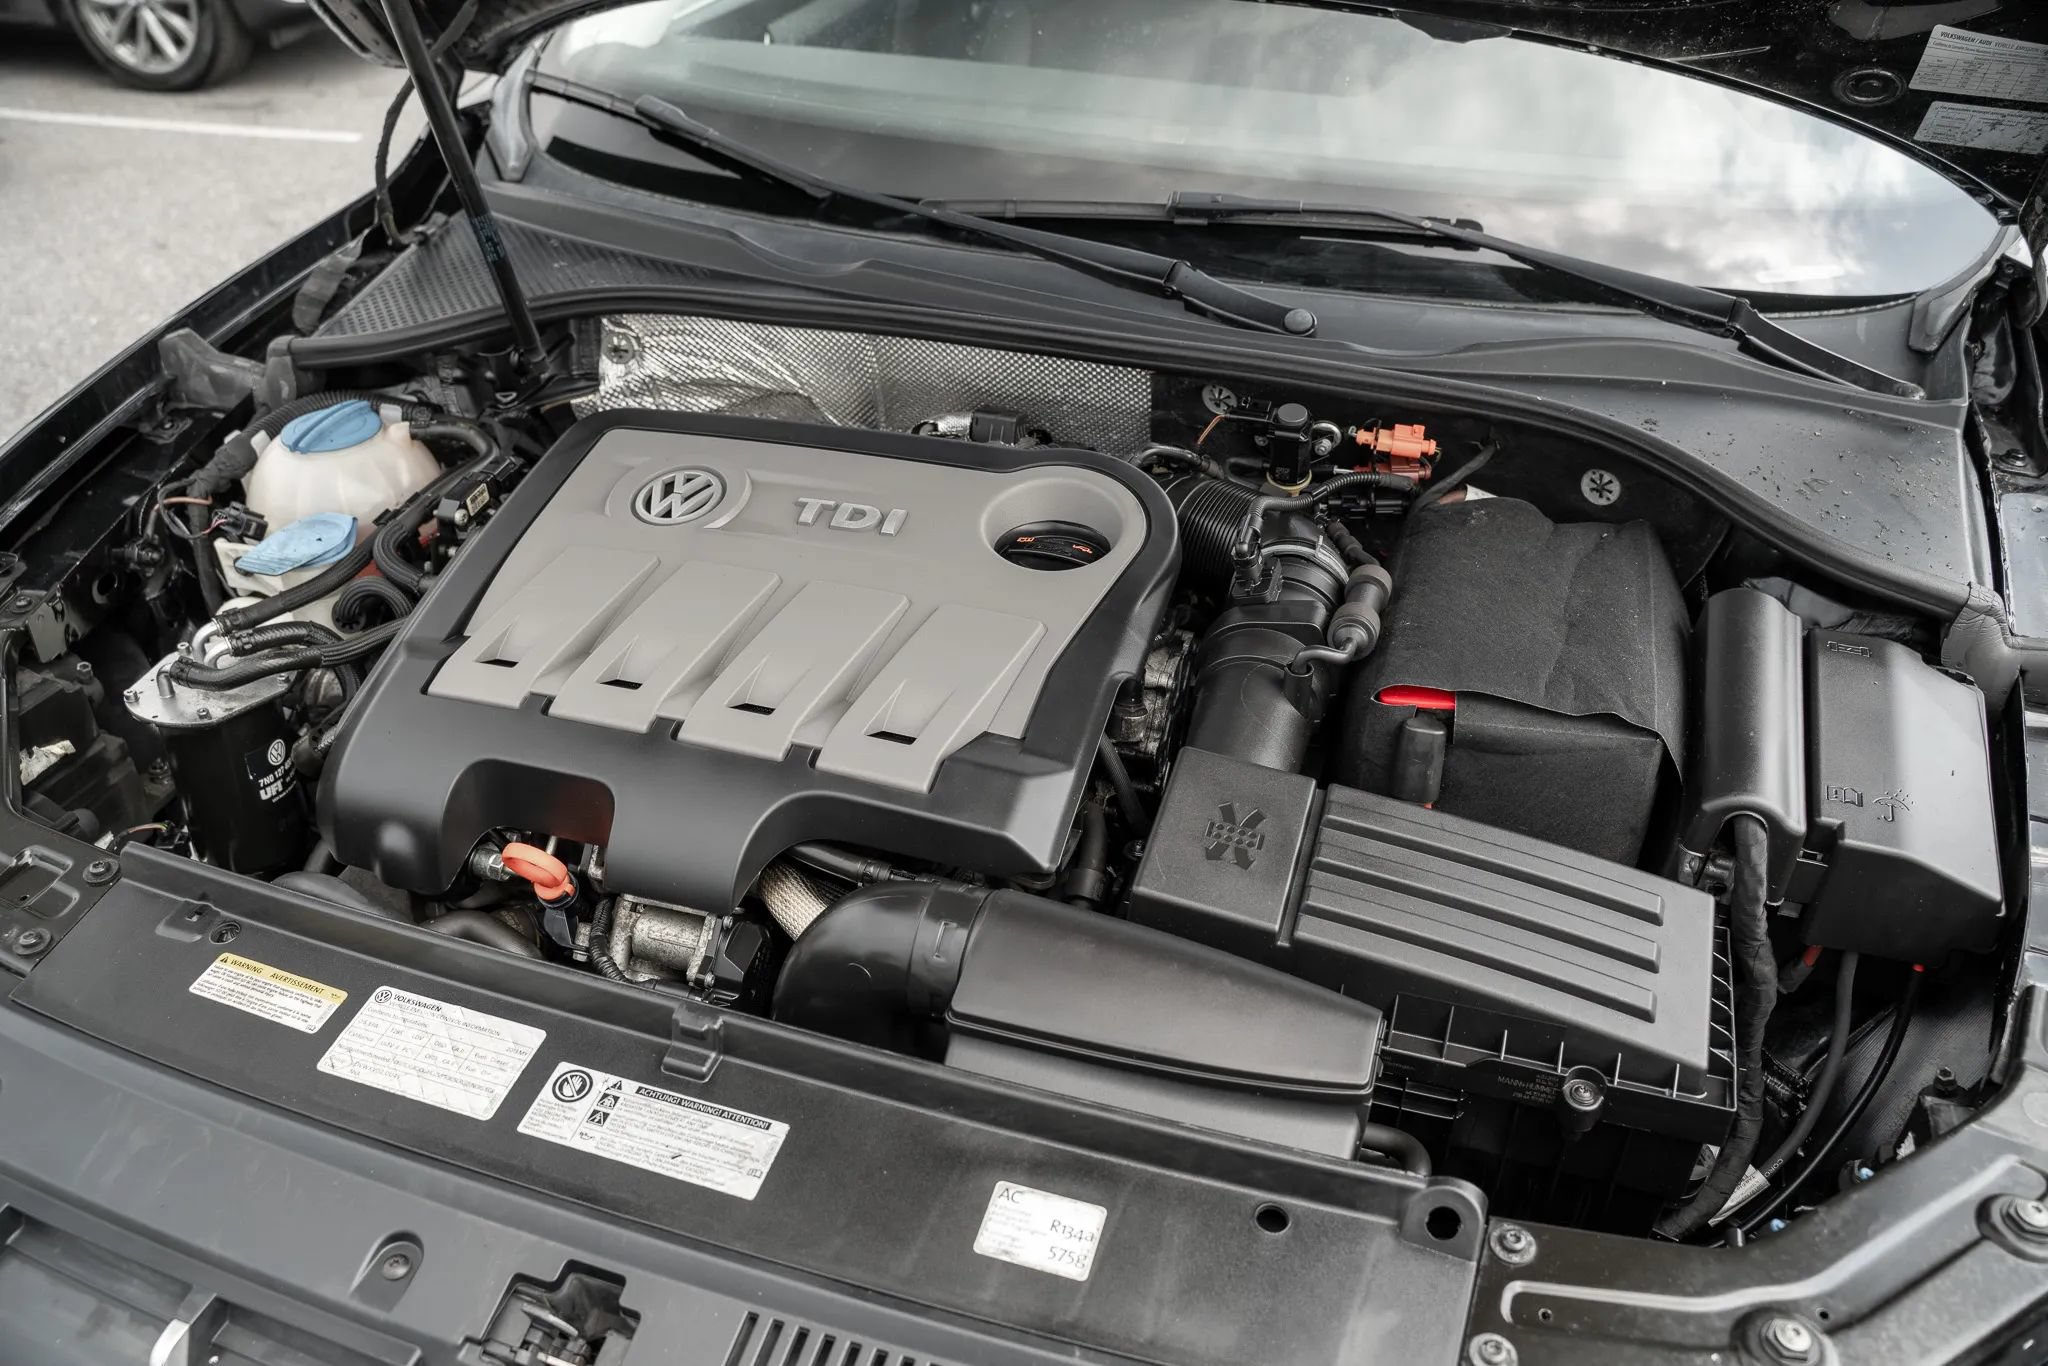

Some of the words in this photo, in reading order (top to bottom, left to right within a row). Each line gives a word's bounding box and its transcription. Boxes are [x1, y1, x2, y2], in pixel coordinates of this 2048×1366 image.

[1940, 30, 1976, 43] VOLKSWAGEN
[1978, 38, 1993, 46] AUDI
[795, 497, 908, 536] TDI
[230, 958, 264, 974] WARNING
[270, 972, 325, 994] AVERTISSEMENT
[394, 993, 442, 1012] VOLKSWAGEN
[639, 1087, 681, 1105] ACHTUNG!
[681, 1098, 722, 1117] WARNING!
[722, 1110, 770, 1130] ATTENTION!
[998, 1187, 1023, 1204] AC
[1050, 1219, 1094, 1243] R134a
[1047, 1245, 1088, 1269] 575g
